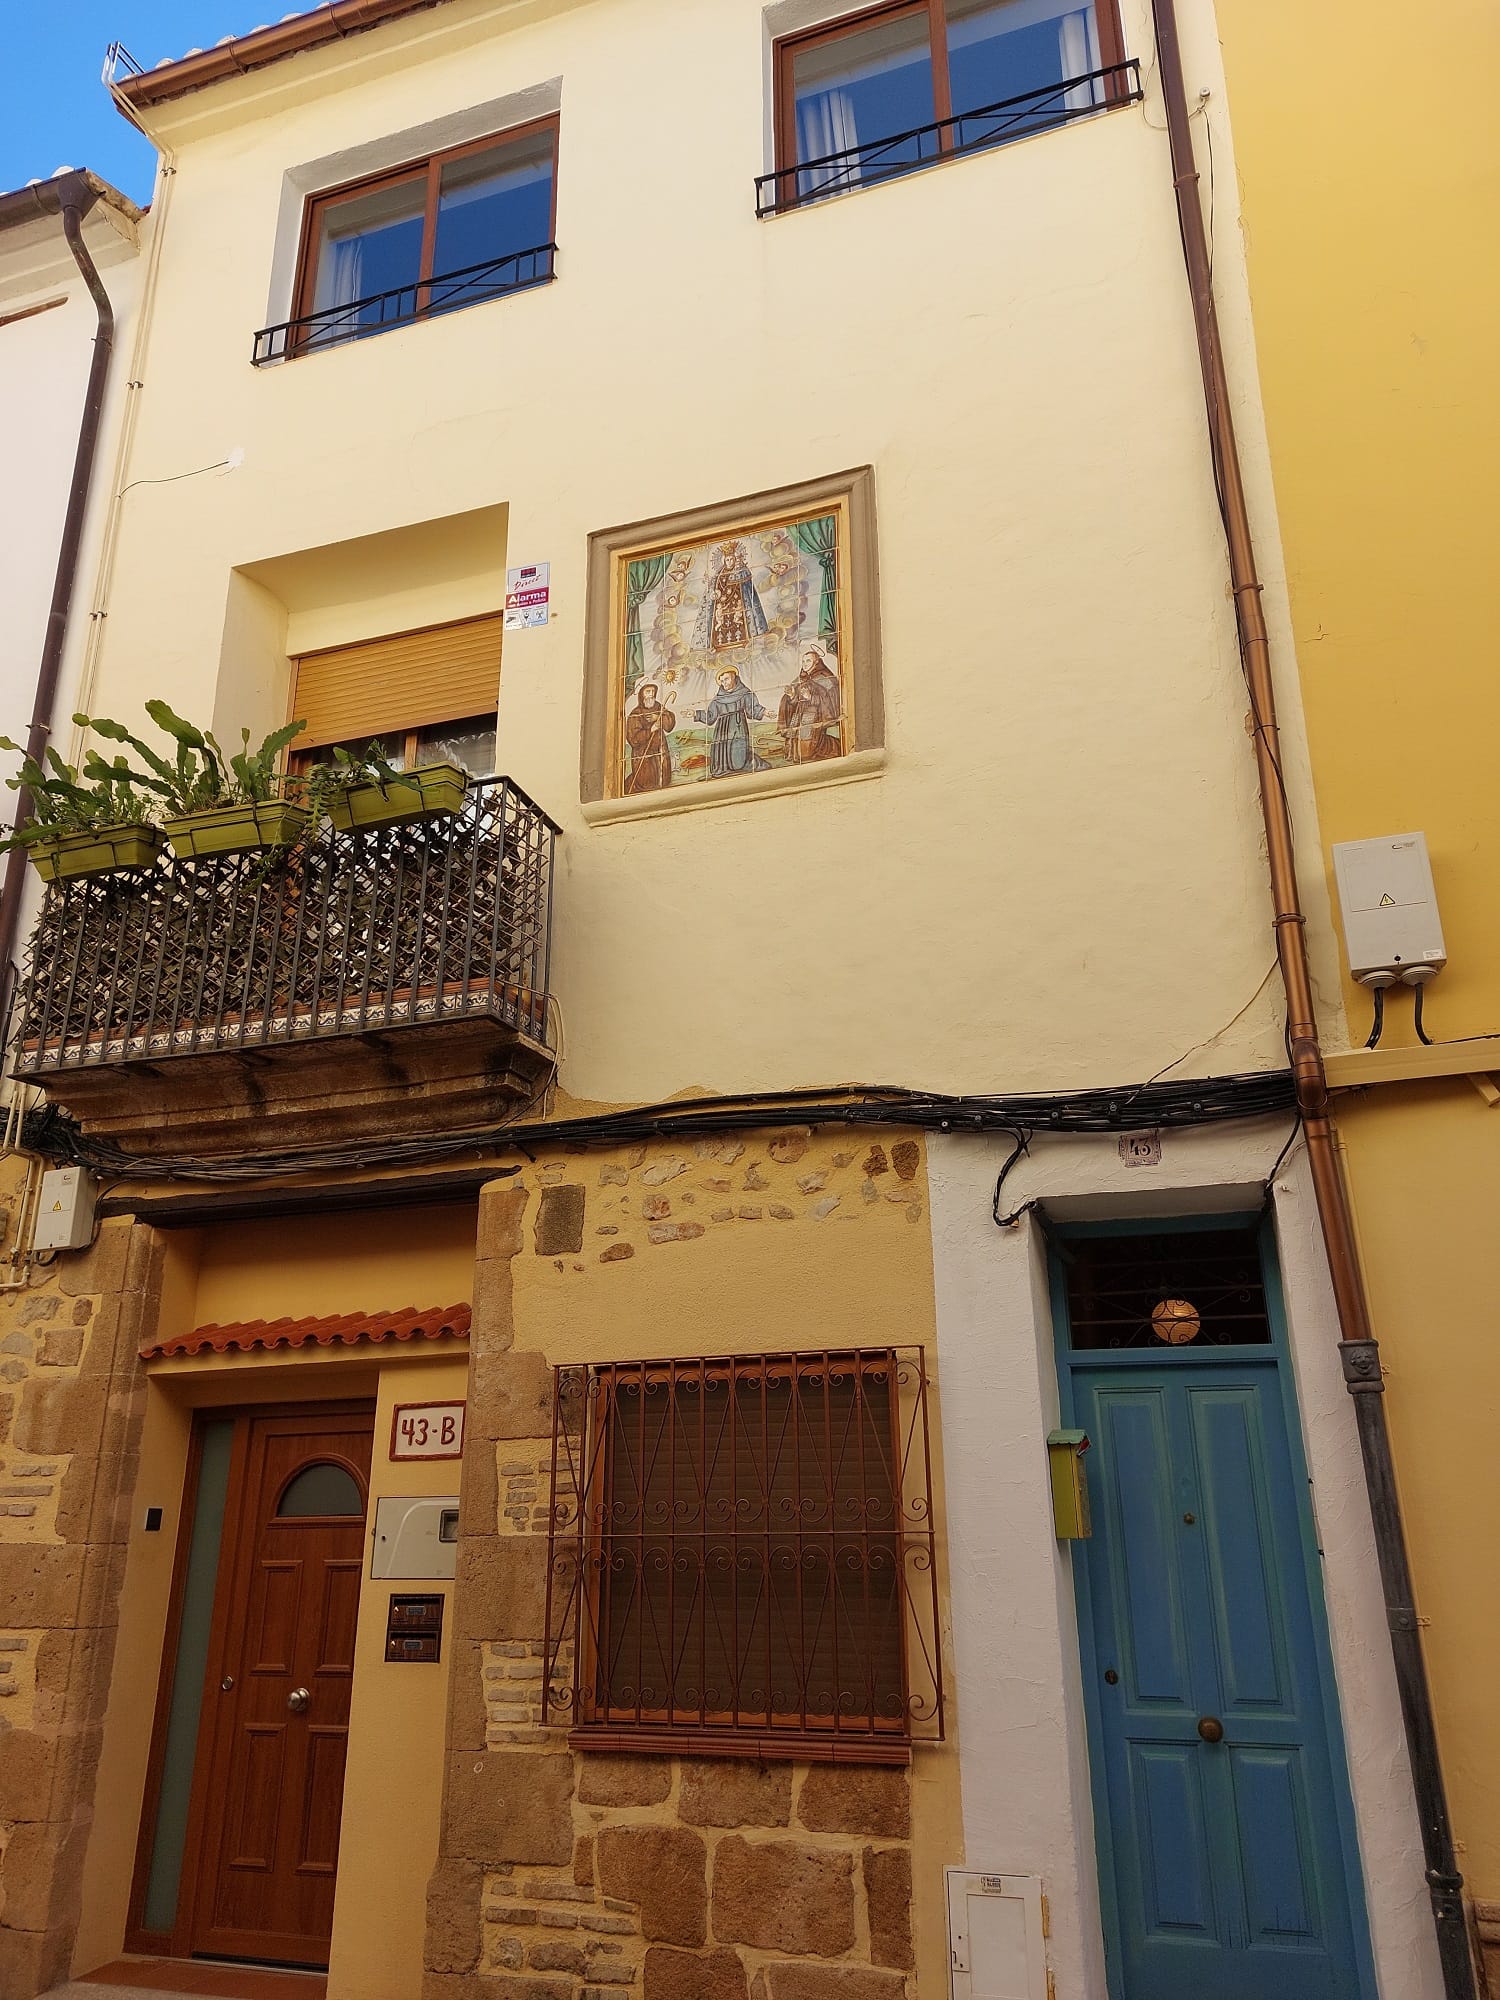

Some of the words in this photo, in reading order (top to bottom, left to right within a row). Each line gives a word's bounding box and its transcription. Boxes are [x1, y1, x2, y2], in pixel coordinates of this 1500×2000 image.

[508, 591, 547, 604] Alarma
[1130, 1138, 1151, 1156] 43
[402, 1416, 455, 1446] 43-B
